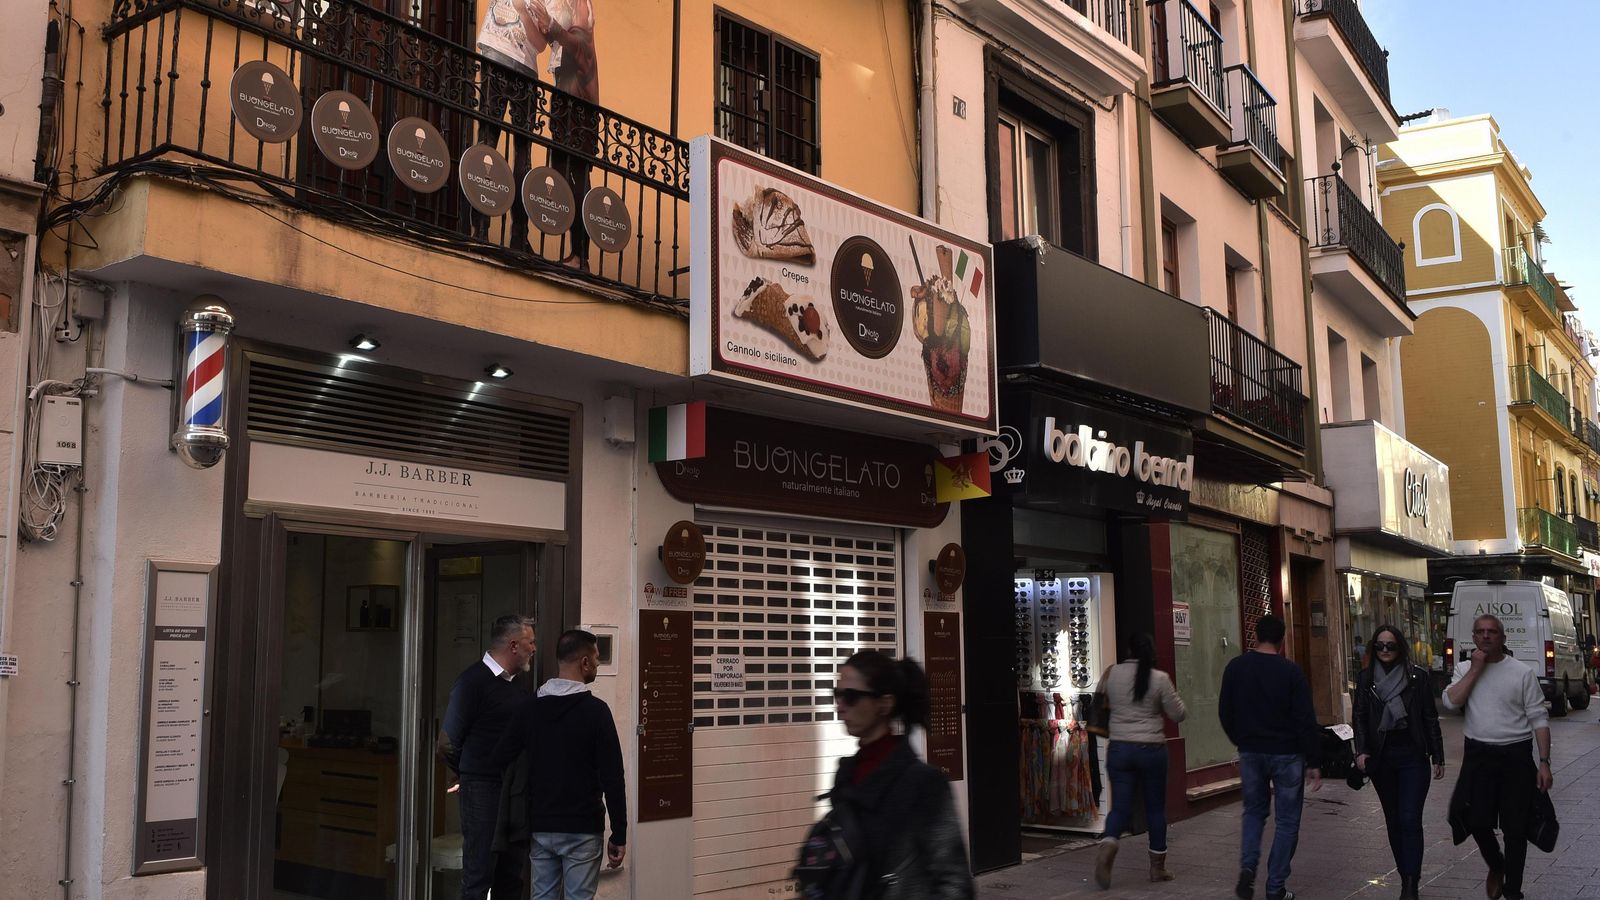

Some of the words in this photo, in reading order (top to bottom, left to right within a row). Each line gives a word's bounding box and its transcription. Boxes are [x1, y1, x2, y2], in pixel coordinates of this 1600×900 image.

[239, 92, 295, 116] BUONGELATO
[953, 97, 966, 119] 78
[321, 125, 372, 140] BUONGELATO
[396, 147, 444, 168] BUONGELATO
[467, 172, 510, 193] BUONGELATO
[529, 193, 570, 213] BUONGELATO
[781, 267, 809, 284] Crepes
[840, 288, 896, 314] BUONGELATO
[726, 340, 761, 359] Cannolo
[764, 350, 797, 367] siciliano
[57, 441, 77, 449] 1068
[1043, 416, 1131, 478] babino
[1133, 440, 1195, 492] bend
[365, 461, 391, 477] J.J.
[400, 465, 472, 487] BARBER
[733, 440, 901, 489] BUONGELATO
[782, 480, 832, 495] naturalmente
[833, 485, 860, 498] italiano
[414, 497, 480, 510] TRADICIONAL
[668, 551, 701, 560] BUONGELATO
[668, 588, 688, 598] FREE
[1474, 602, 1523, 617] AISOL
[716, 657, 740, 665] CERRADO
[714, 672, 743, 680] TEMPORADA
